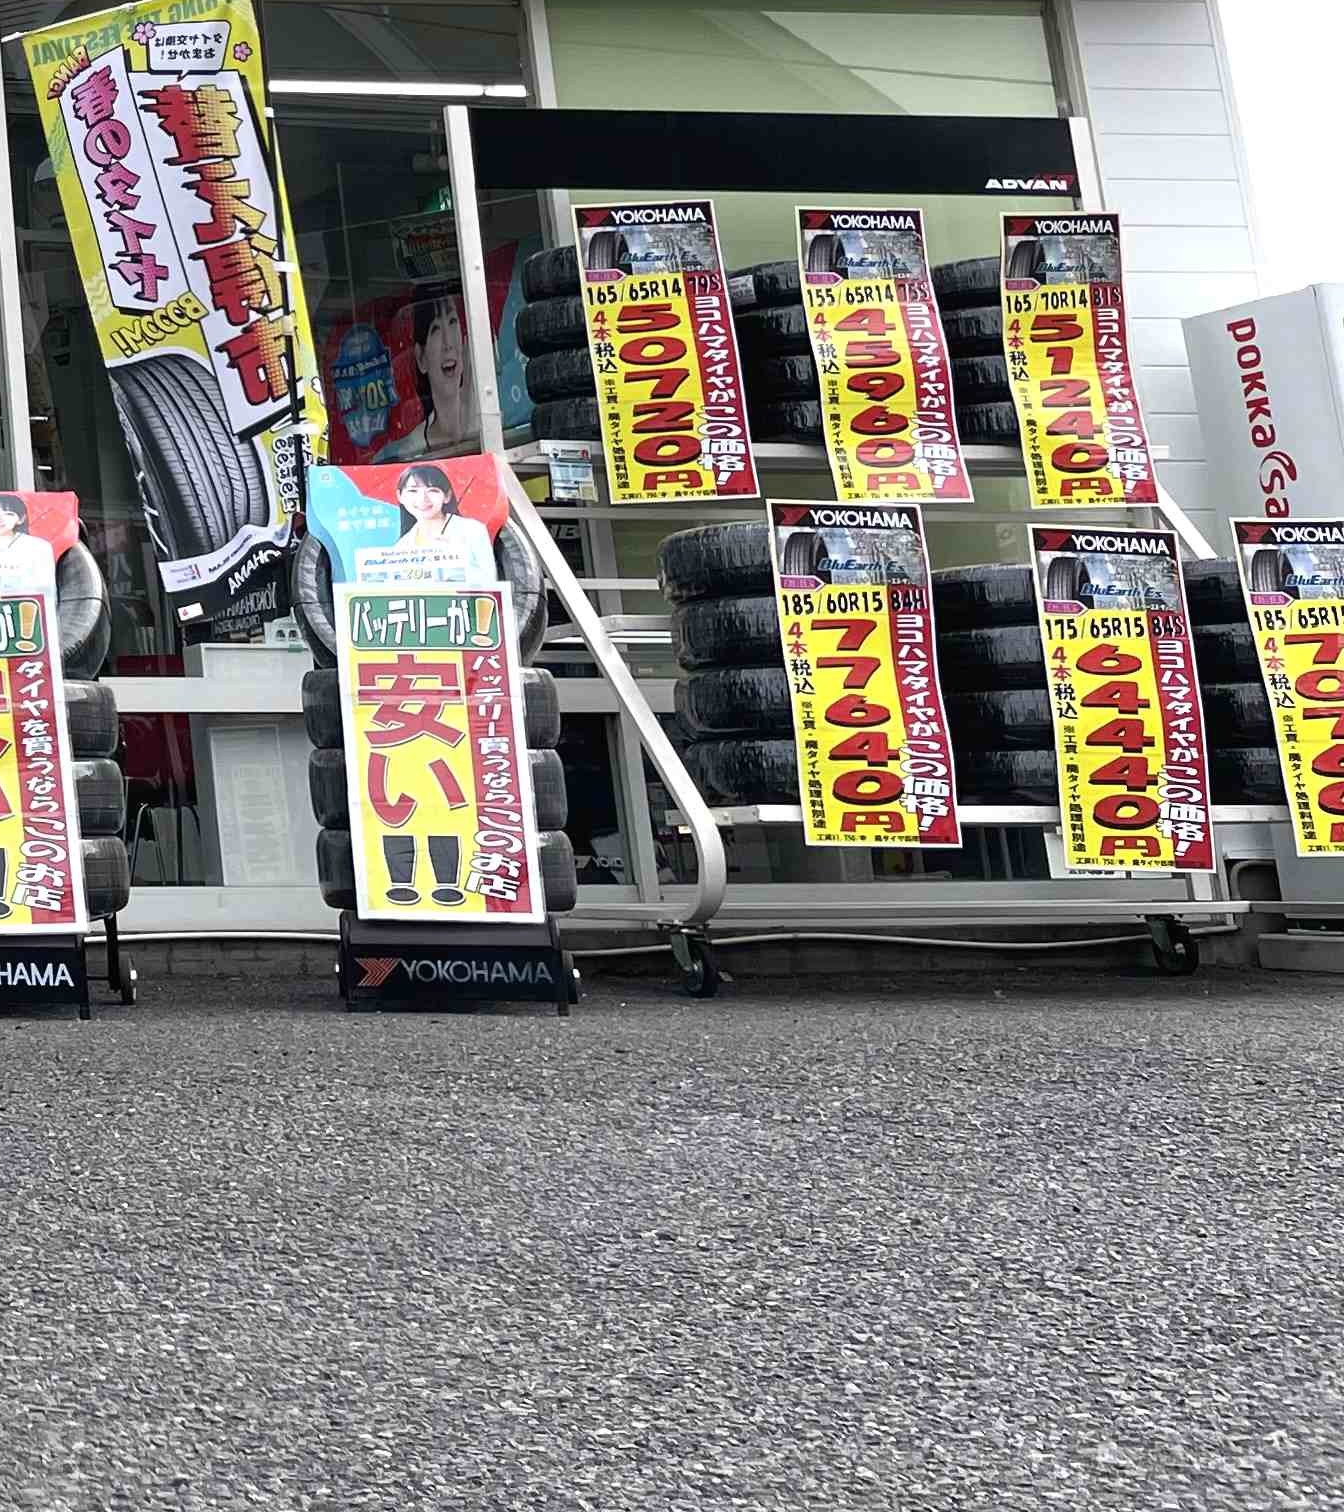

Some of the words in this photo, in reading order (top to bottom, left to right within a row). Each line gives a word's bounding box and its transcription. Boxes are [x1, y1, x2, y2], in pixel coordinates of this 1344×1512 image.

[985, 178, 1067, 191] ADVAN
[611, 207, 706, 224] YOKOHAMA
[831, 214, 915, 230] YOKOHAMA
[1034, 220, 1113, 234] YOKOHAMA
[810, 510, 912, 529] YOKOHAMA
[1271, 527, 1344, 544] YOKOHA
[1071, 534, 1170, 555] YOKOHAMA
[357, 654, 470, 828] 安い
[400, 958, 554, 985] YOKOHAMA
